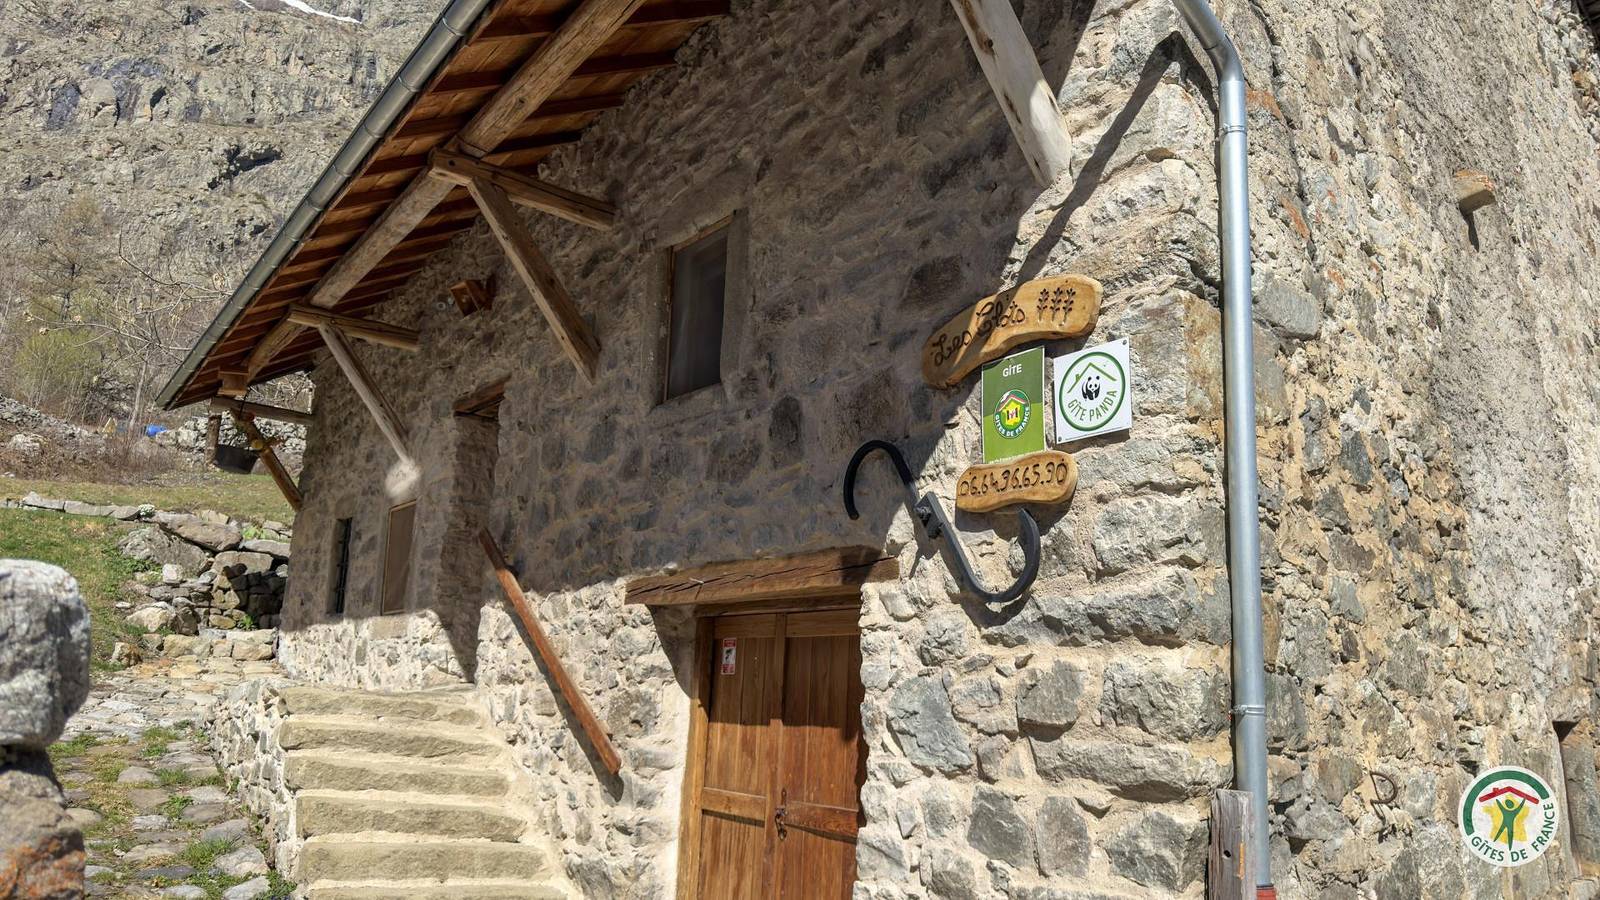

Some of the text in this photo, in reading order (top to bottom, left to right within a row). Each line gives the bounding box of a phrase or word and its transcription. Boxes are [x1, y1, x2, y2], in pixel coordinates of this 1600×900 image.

[931, 330, 973, 367] Les
[1067, 390, 1118, 422] GÎTE PANDA
